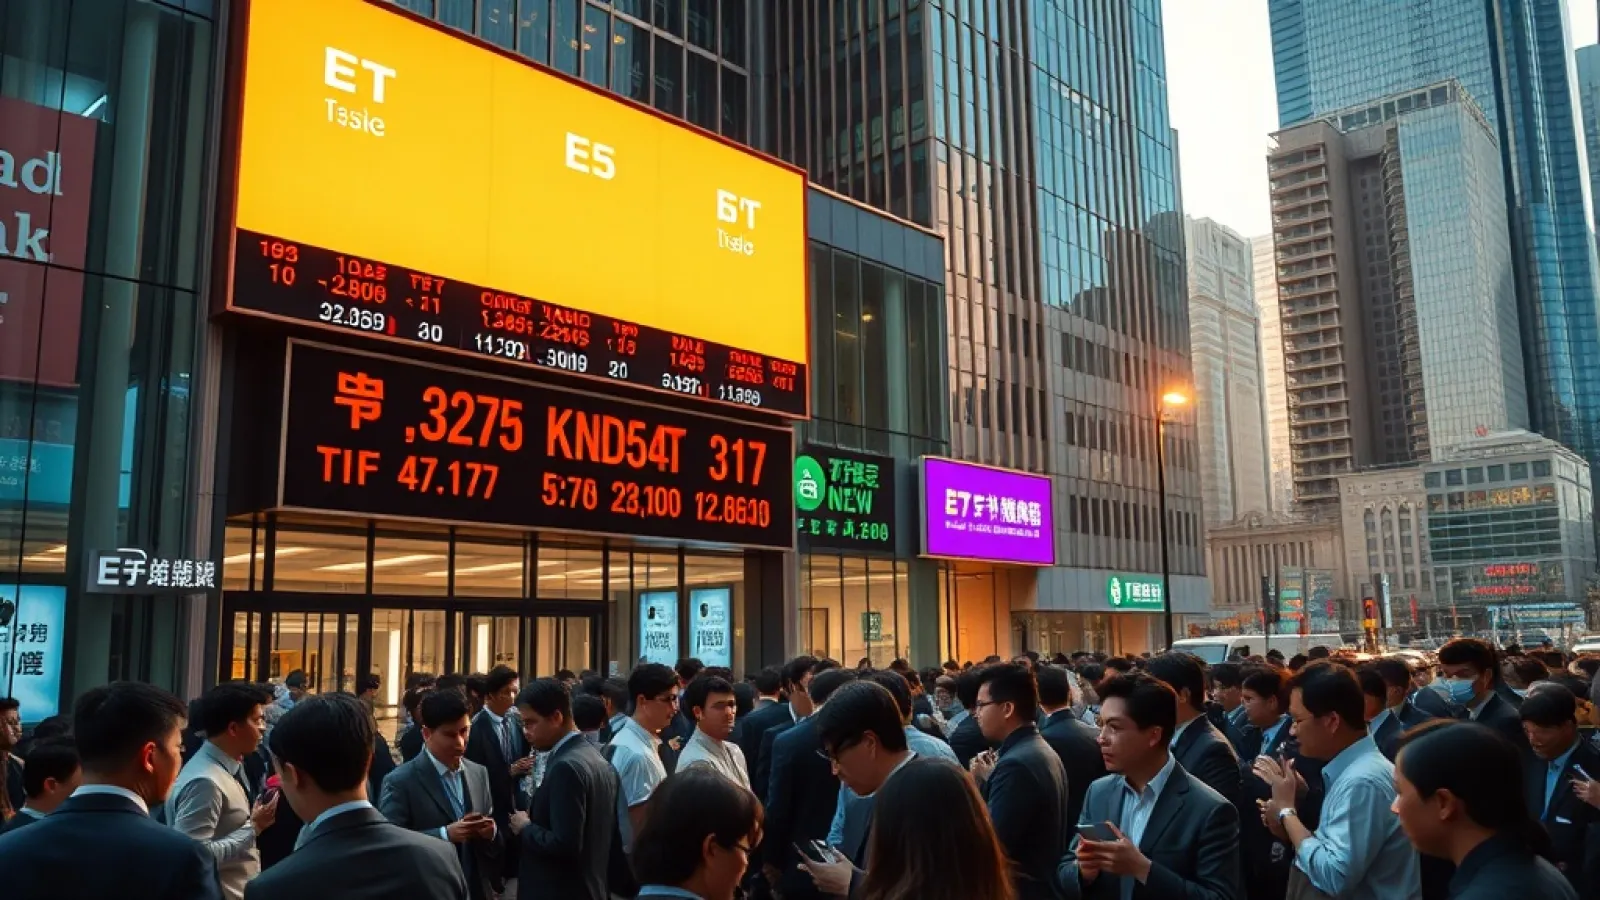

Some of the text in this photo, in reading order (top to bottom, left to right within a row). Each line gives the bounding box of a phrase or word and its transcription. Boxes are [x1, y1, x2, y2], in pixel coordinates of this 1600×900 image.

[324, 46, 397, 104] ET
[565, 132, 616, 180] E5
[316, 446, 380, 486] TIF
[398, 455, 499, 500] 47.177
[709, 434, 766, 486] 317
[828, 485, 873, 515] NEW
